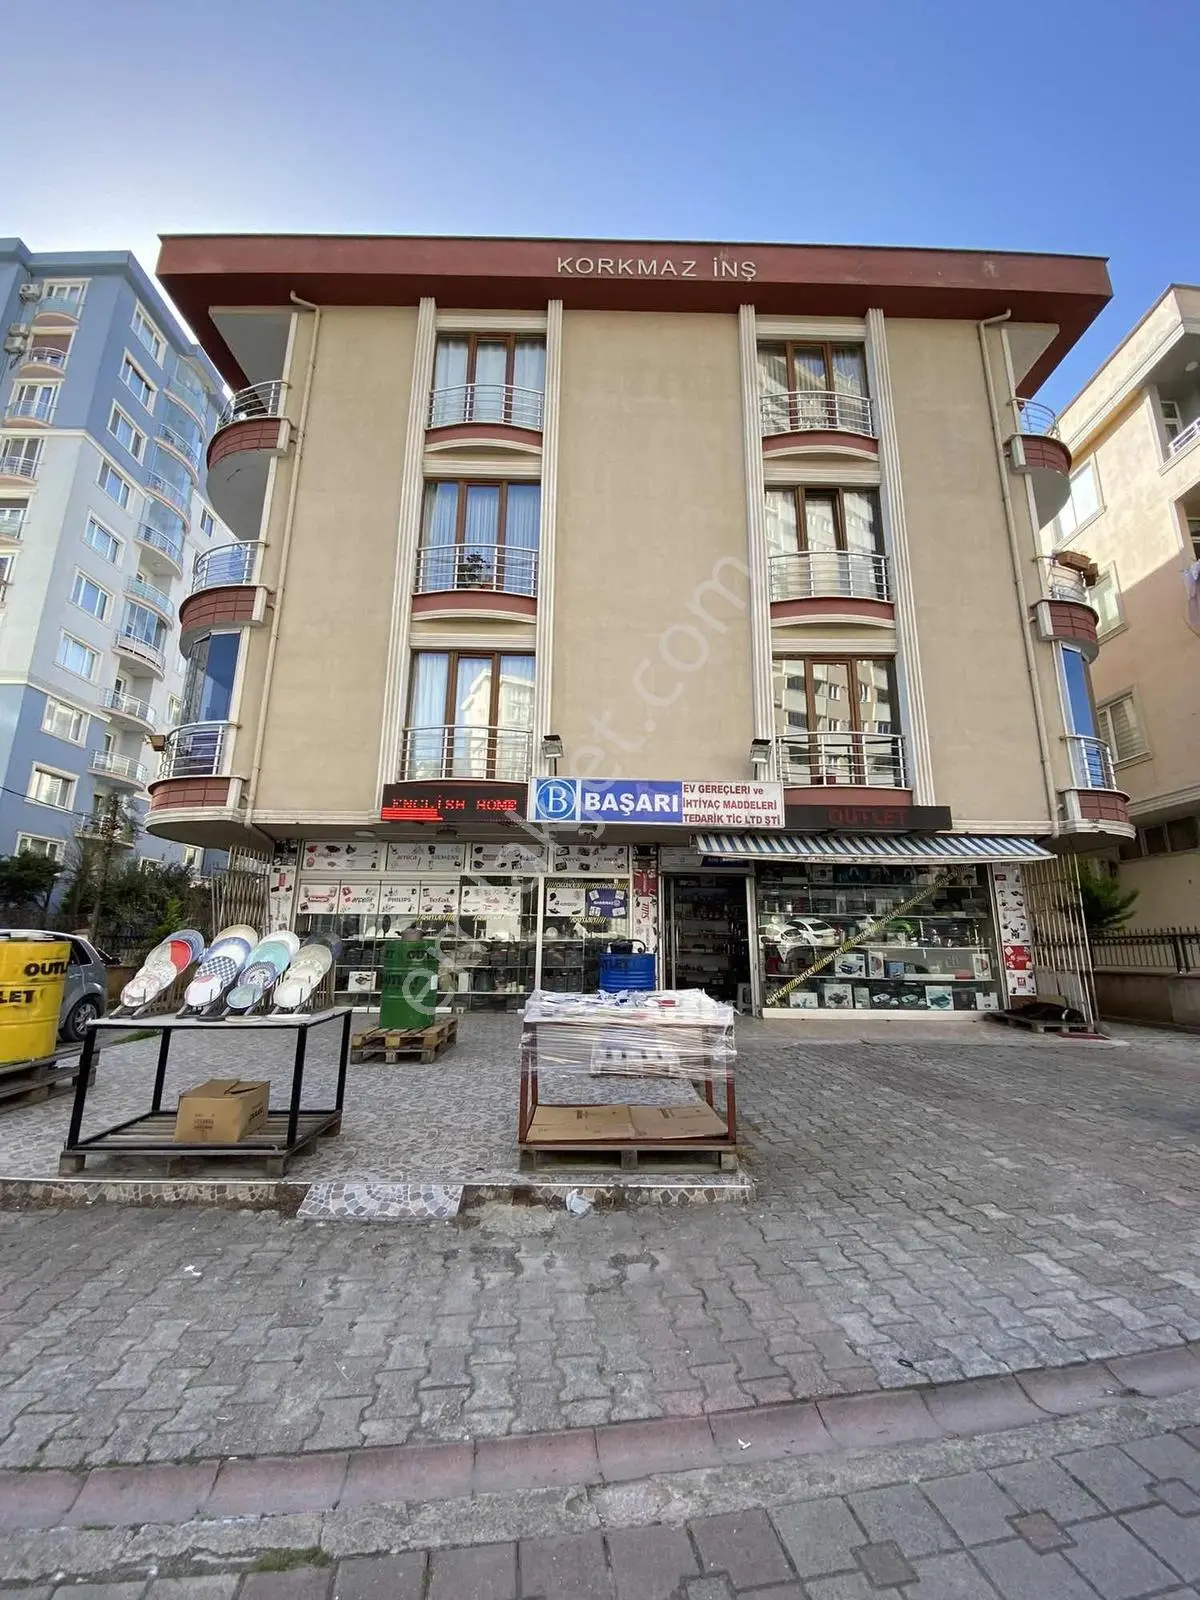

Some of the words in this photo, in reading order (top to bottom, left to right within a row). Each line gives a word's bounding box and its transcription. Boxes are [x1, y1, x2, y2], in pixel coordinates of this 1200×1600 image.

[557, 256, 697, 277] KORKMAZ
[712, 256, 757, 281] İNŞ
[683, 784, 695, 793] EV
[753, 787, 765, 795] ve
[476, 799, 518, 810] HOME
[547, 786, 568, 813] B
[584, 793, 679, 816] BAŞARI
[682, 797, 720, 810] İHTİYAÇ
[722, 799, 778, 810] MADDELERİ
[683, 812, 724, 824] TEDARİK
[726, 812, 743, 824] TİC
[744, 815, 762, 824] LTD
[764, 814, 781, 826] ŞTİ
[829, 808, 909, 825] OUTLET
